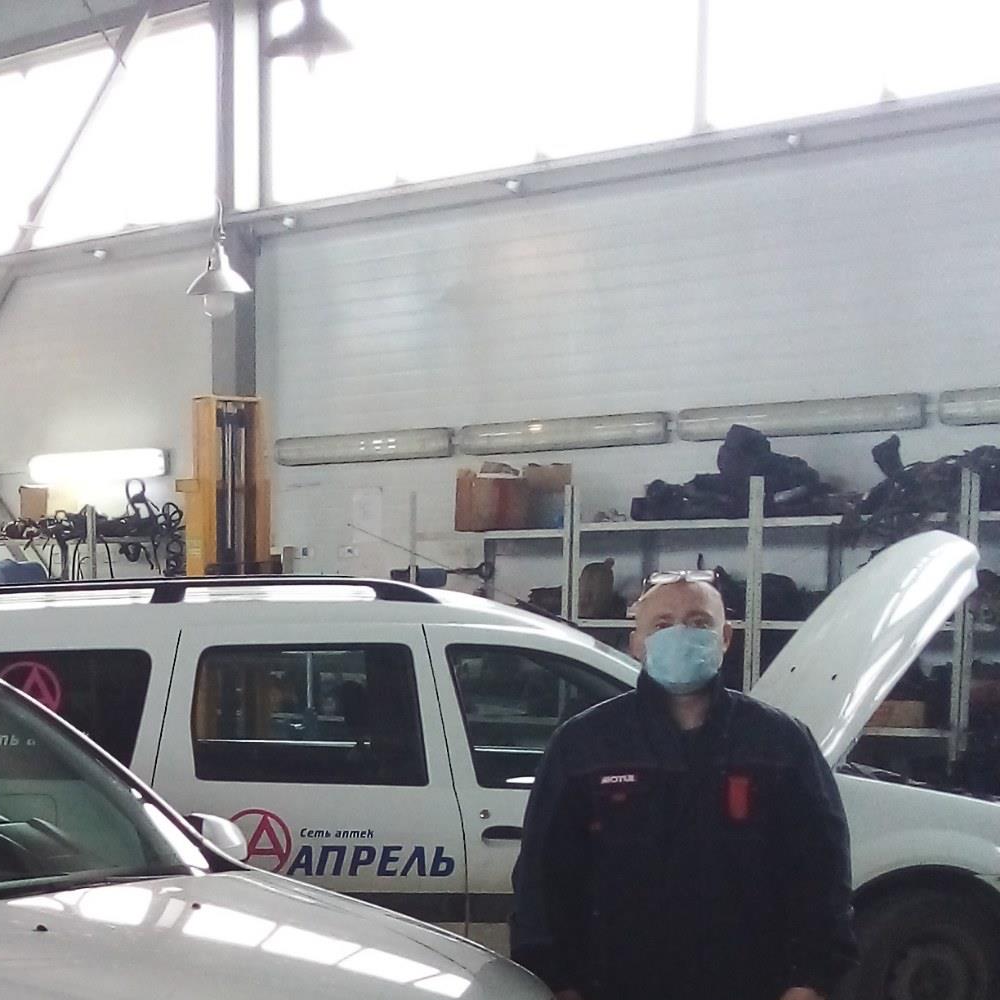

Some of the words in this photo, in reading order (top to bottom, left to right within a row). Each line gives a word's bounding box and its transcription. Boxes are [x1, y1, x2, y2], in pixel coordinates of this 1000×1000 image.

[299, 827, 332, 839] Сеть
[334, 828, 375, 840] аптек
[286, 844, 456, 878] АПРЕЛЬ
